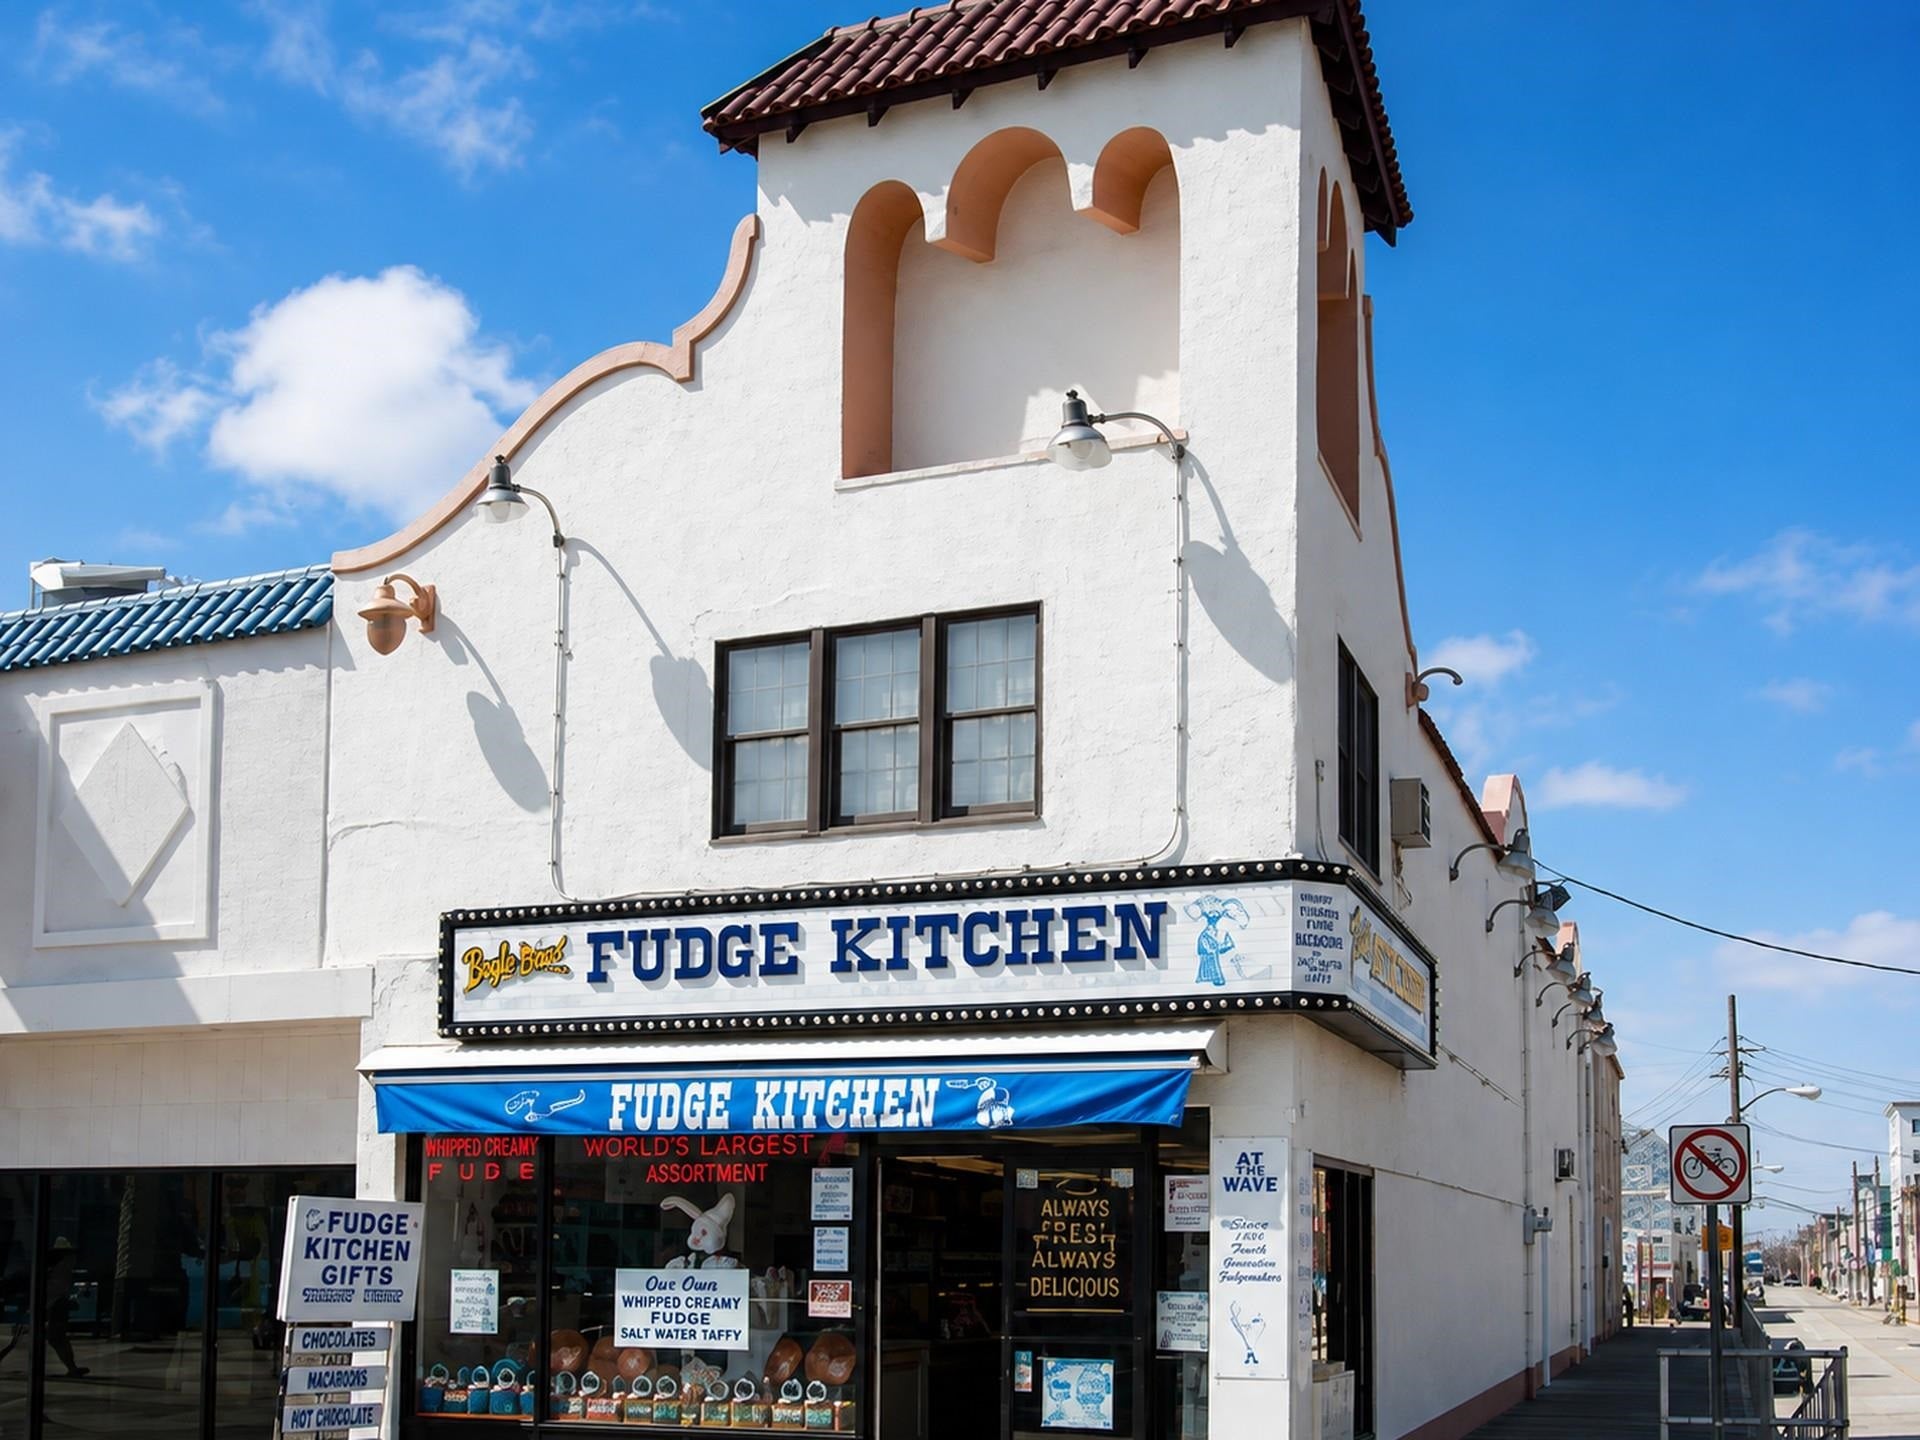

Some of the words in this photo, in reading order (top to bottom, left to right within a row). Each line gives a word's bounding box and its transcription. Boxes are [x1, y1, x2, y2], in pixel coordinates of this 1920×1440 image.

[587, 921, 799, 983] FUDGE
[830, 901, 1167, 973] KITCHEN
[609, 1081, 732, 1131] FUDGE
[752, 1078, 941, 1130] KITCHEN
[425, 1136, 481, 1158] WHIPPED
[484, 1136, 539, 1157] CREAMY
[584, 1136, 689, 1157] WORLD'S
[700, 1134, 815, 1156] LARGEST
[1236, 1152, 1264, 1165] AT
[646, 1163, 769, 1183] ASSORTMENT
[1235, 1165, 1265, 1176] THE
[1222, 1176, 1278, 1192] WAVE
[1041, 1199, 1110, 1217] ALWAYS
[327, 1211, 409, 1235] FUDGE
[304, 1237, 411, 1261] KITCHEN
[1031, 1251, 1117, 1269] ALWAYS
[321, 1265, 393, 1286] GIFTS
[682, 1275, 718, 1291] Own
[1030, 1276, 1120, 1298] DELICIOUS
[622, 1295, 681, 1309] WHIPPED
[685, 1296, 742, 1310] CREAMY
[651, 1311, 711, 1325] FUDGE
[302, 1331, 376, 1349] CHOCOLATES
[620, 1327, 651, 1339] SALT
[655, 1328, 698, 1340] WATER
[701, 1329, 742, 1341] TAFFY
